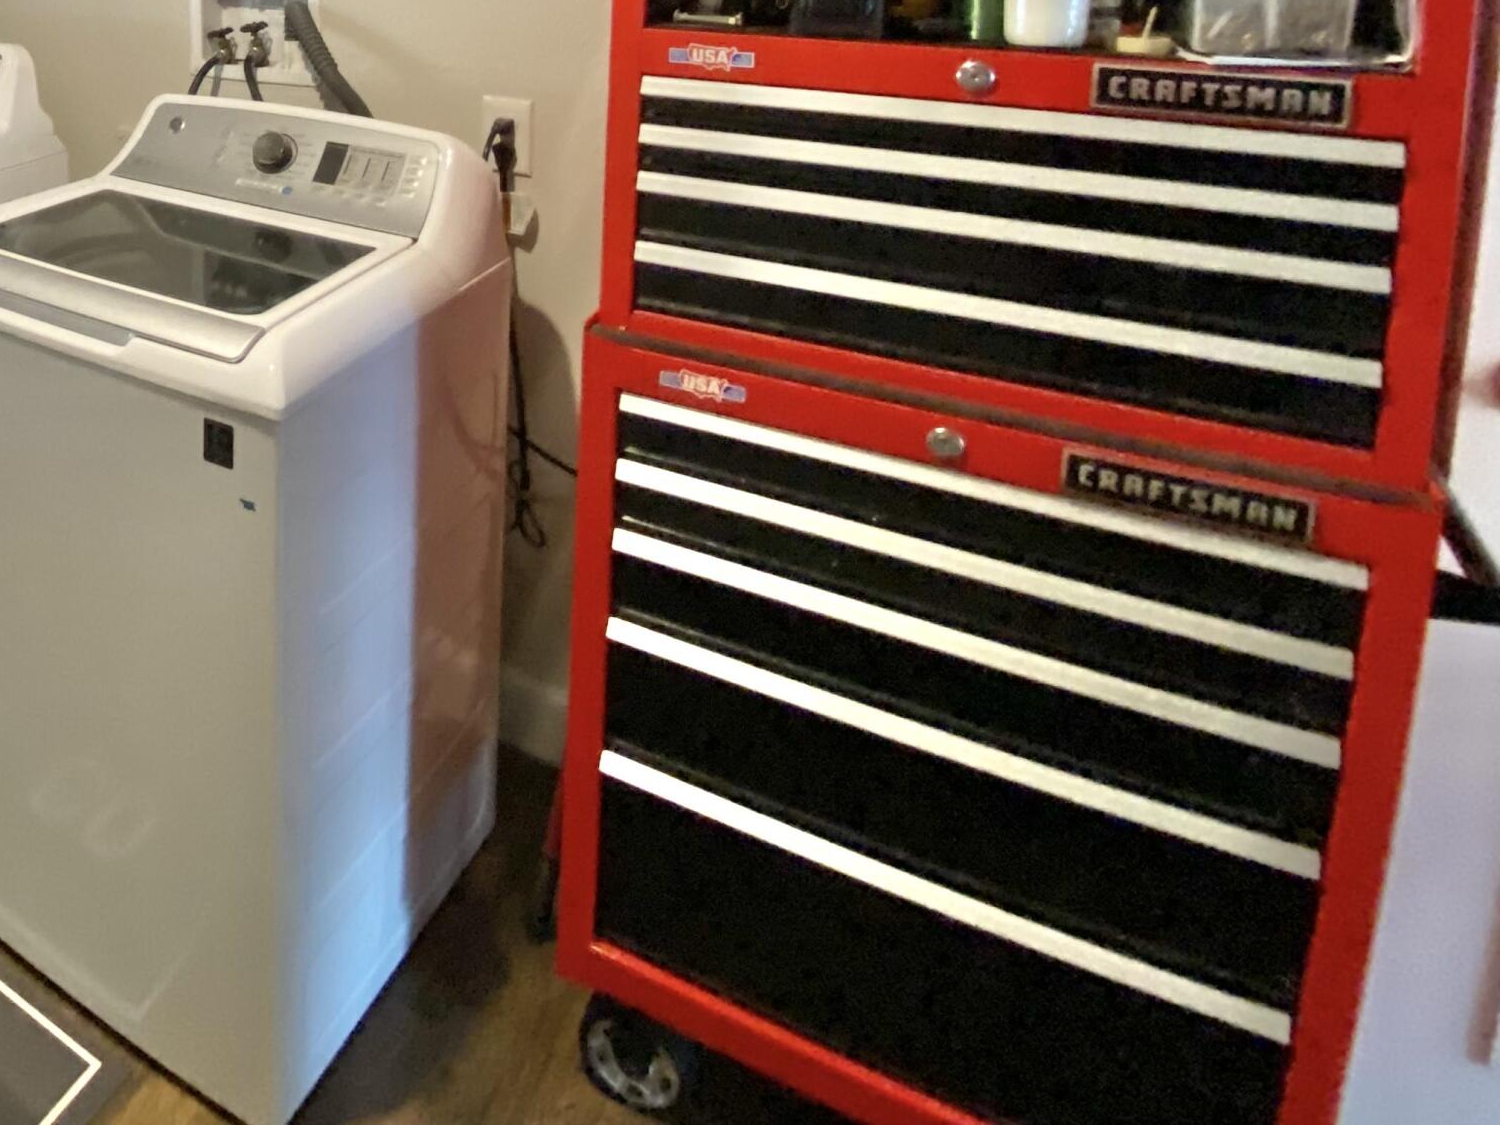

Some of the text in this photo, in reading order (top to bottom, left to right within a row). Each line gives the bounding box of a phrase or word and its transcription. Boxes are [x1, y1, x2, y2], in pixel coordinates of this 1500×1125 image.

[692, 47, 729, 65] USA
[1107, 75, 1332, 116] CRAFTSMAN
[683, 374, 720, 395] USA
[1077, 463, 1297, 531] CRAFTSMAN
